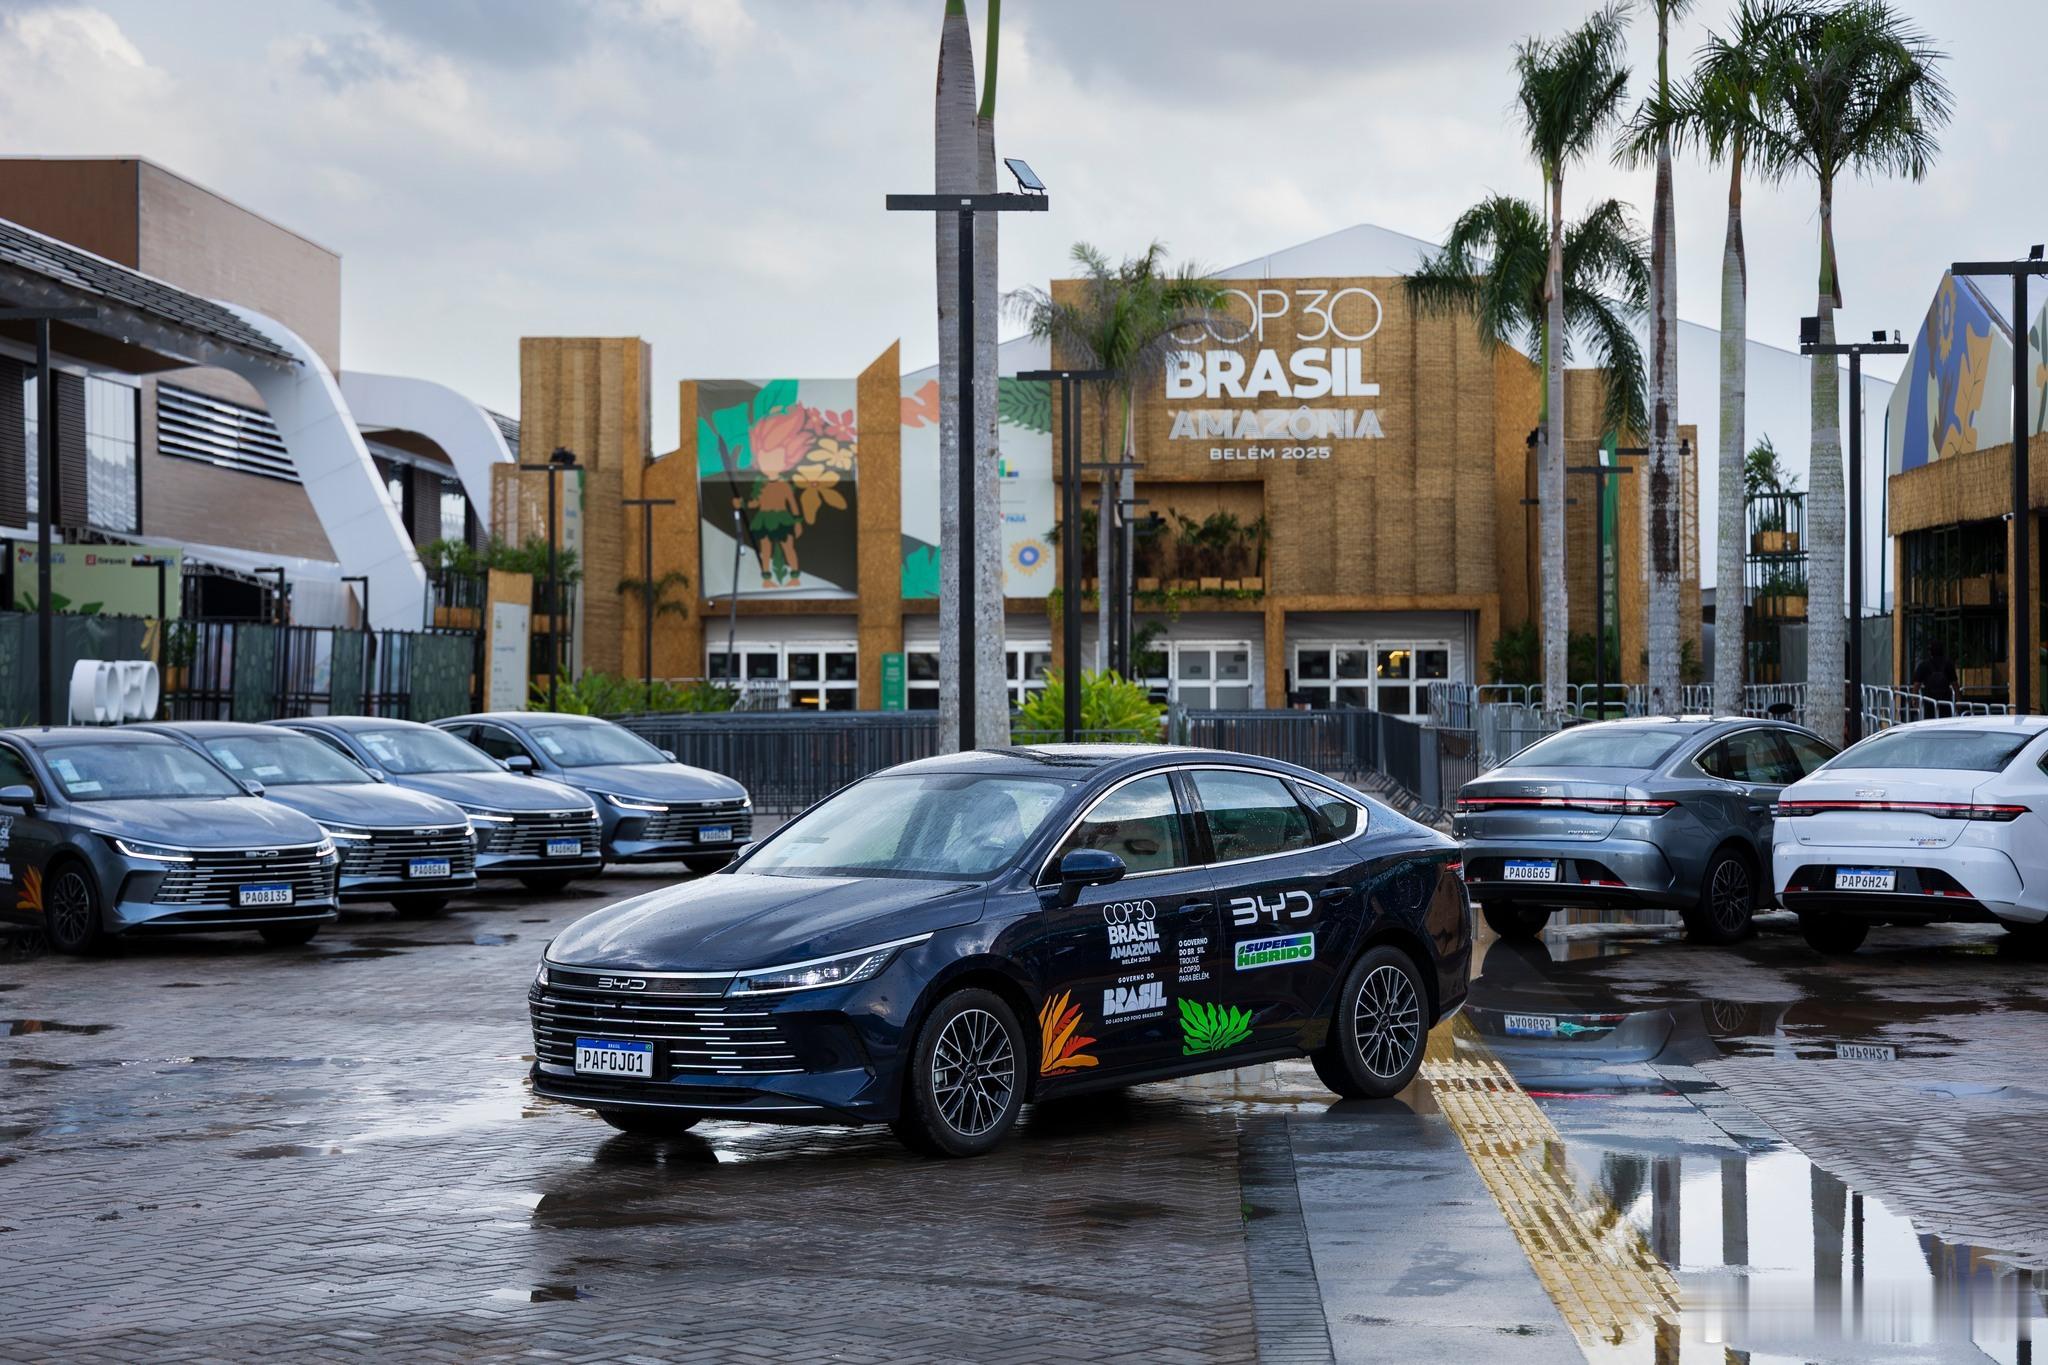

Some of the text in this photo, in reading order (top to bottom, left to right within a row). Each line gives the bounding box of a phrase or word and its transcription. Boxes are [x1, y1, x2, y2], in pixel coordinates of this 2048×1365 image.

[1165, 347, 1380, 399] BRASIL
[1168, 405, 1385, 440] AMAZÔNIA
[1210, 445, 1330, 460] BELÉM 2025
[1841, 875, 1889, 888] PAP6H24
[1103, 900, 1156, 925] COP30
[1230, 890, 1313, 926] BYD
[1108, 921, 1159, 944] BRASIL
[1110, 941, 1161, 959] AMAZÔNIA
[1187, 947, 1205, 955] BRSIL
[1245, 939, 1287, 953] SUPER
[1122, 957, 1137, 965] BELÉM
[598, 978, 647, 990] BYD
[1118, 974, 1144, 983] GOVERNO
[1103, 981, 1167, 1016] BRASIL
[583, 1050, 643, 1073] PAF0J01
